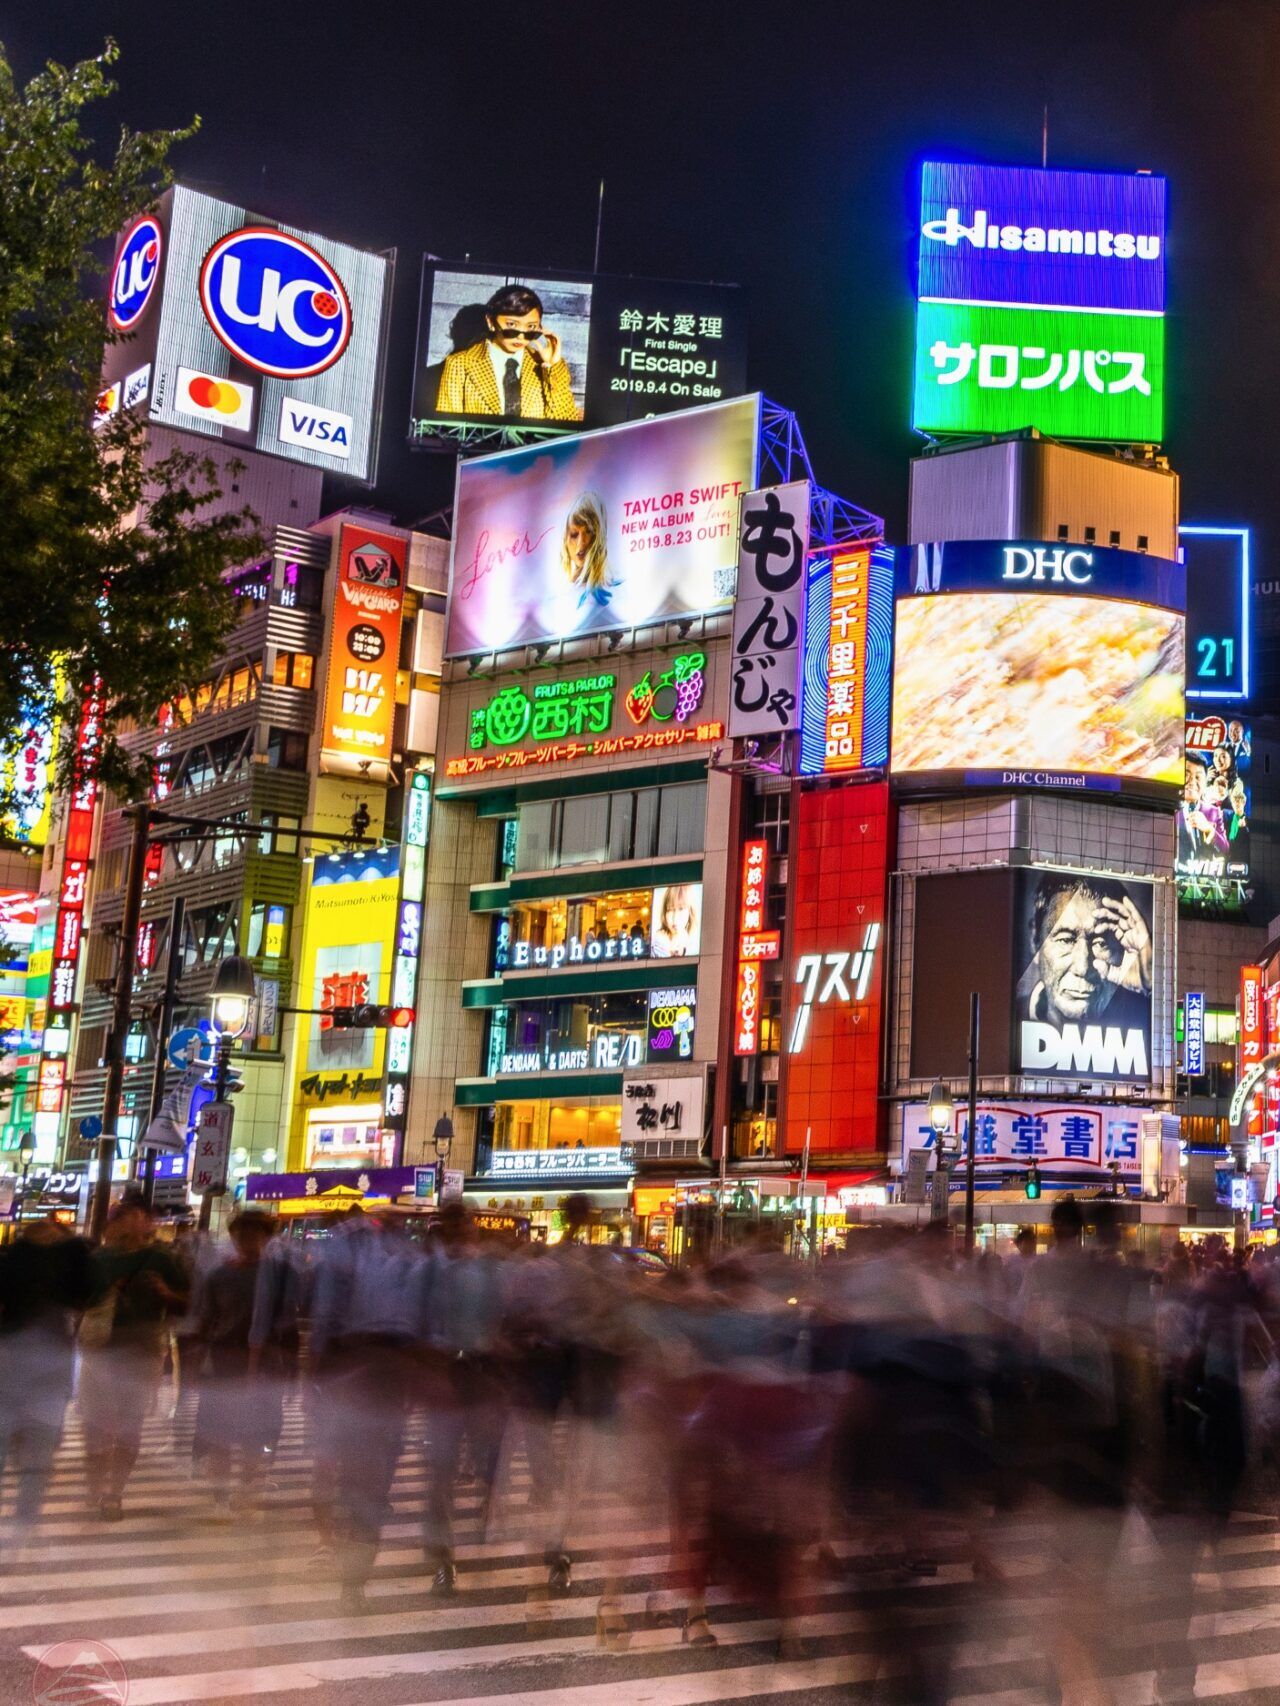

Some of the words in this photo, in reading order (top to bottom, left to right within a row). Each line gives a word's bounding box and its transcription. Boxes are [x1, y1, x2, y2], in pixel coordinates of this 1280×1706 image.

[922, 208, 1160, 260] Hisamitsu
[117, 244, 154, 304] UC
[220, 254, 334, 347] UC
[619, 308, 723, 339] 鈴木愛理
[645, 338, 666, 349] First
[668, 340, 697, 352] Single
[930, 340, 1151, 396] サロンパス
[611, 379, 667, 394] 2019.9.4
[670, 382, 689, 396] On
[693, 385, 721, 398] Sale
[290, 411, 348, 446] VISA
[624, 492, 684, 517] TAYLOR
[690, 481, 742, 505] SWIFT
[621, 519, 649, 535] NEW
[652, 512, 695, 529] ALBUM
[630, 530, 692, 553] 2019.8.23
[698, 523, 731, 541] OUT!
[1002, 546, 1094, 583] DHC
[734, 492, 804, 726] もんじゃ
[824, 560, 862, 758] 三千里薬品
[1197, 638, 1234, 677] 21
[470, 709, 486, 749] 渋谷
[531, 692, 613, 741] 西村
[1002, 771, 1032, 784] DHC
[1035, 771, 1086, 787] Channel
[743, 846, 764, 928] お好み焼
[513, 935, 644, 969] Euphoria
[558, 1050, 588, 1071] DARTS
[1022, 1021, 1149, 1076] DMM
[635, 1100, 682, 1131] 松川
[197, 1110, 219, 1185] 道玄坂
